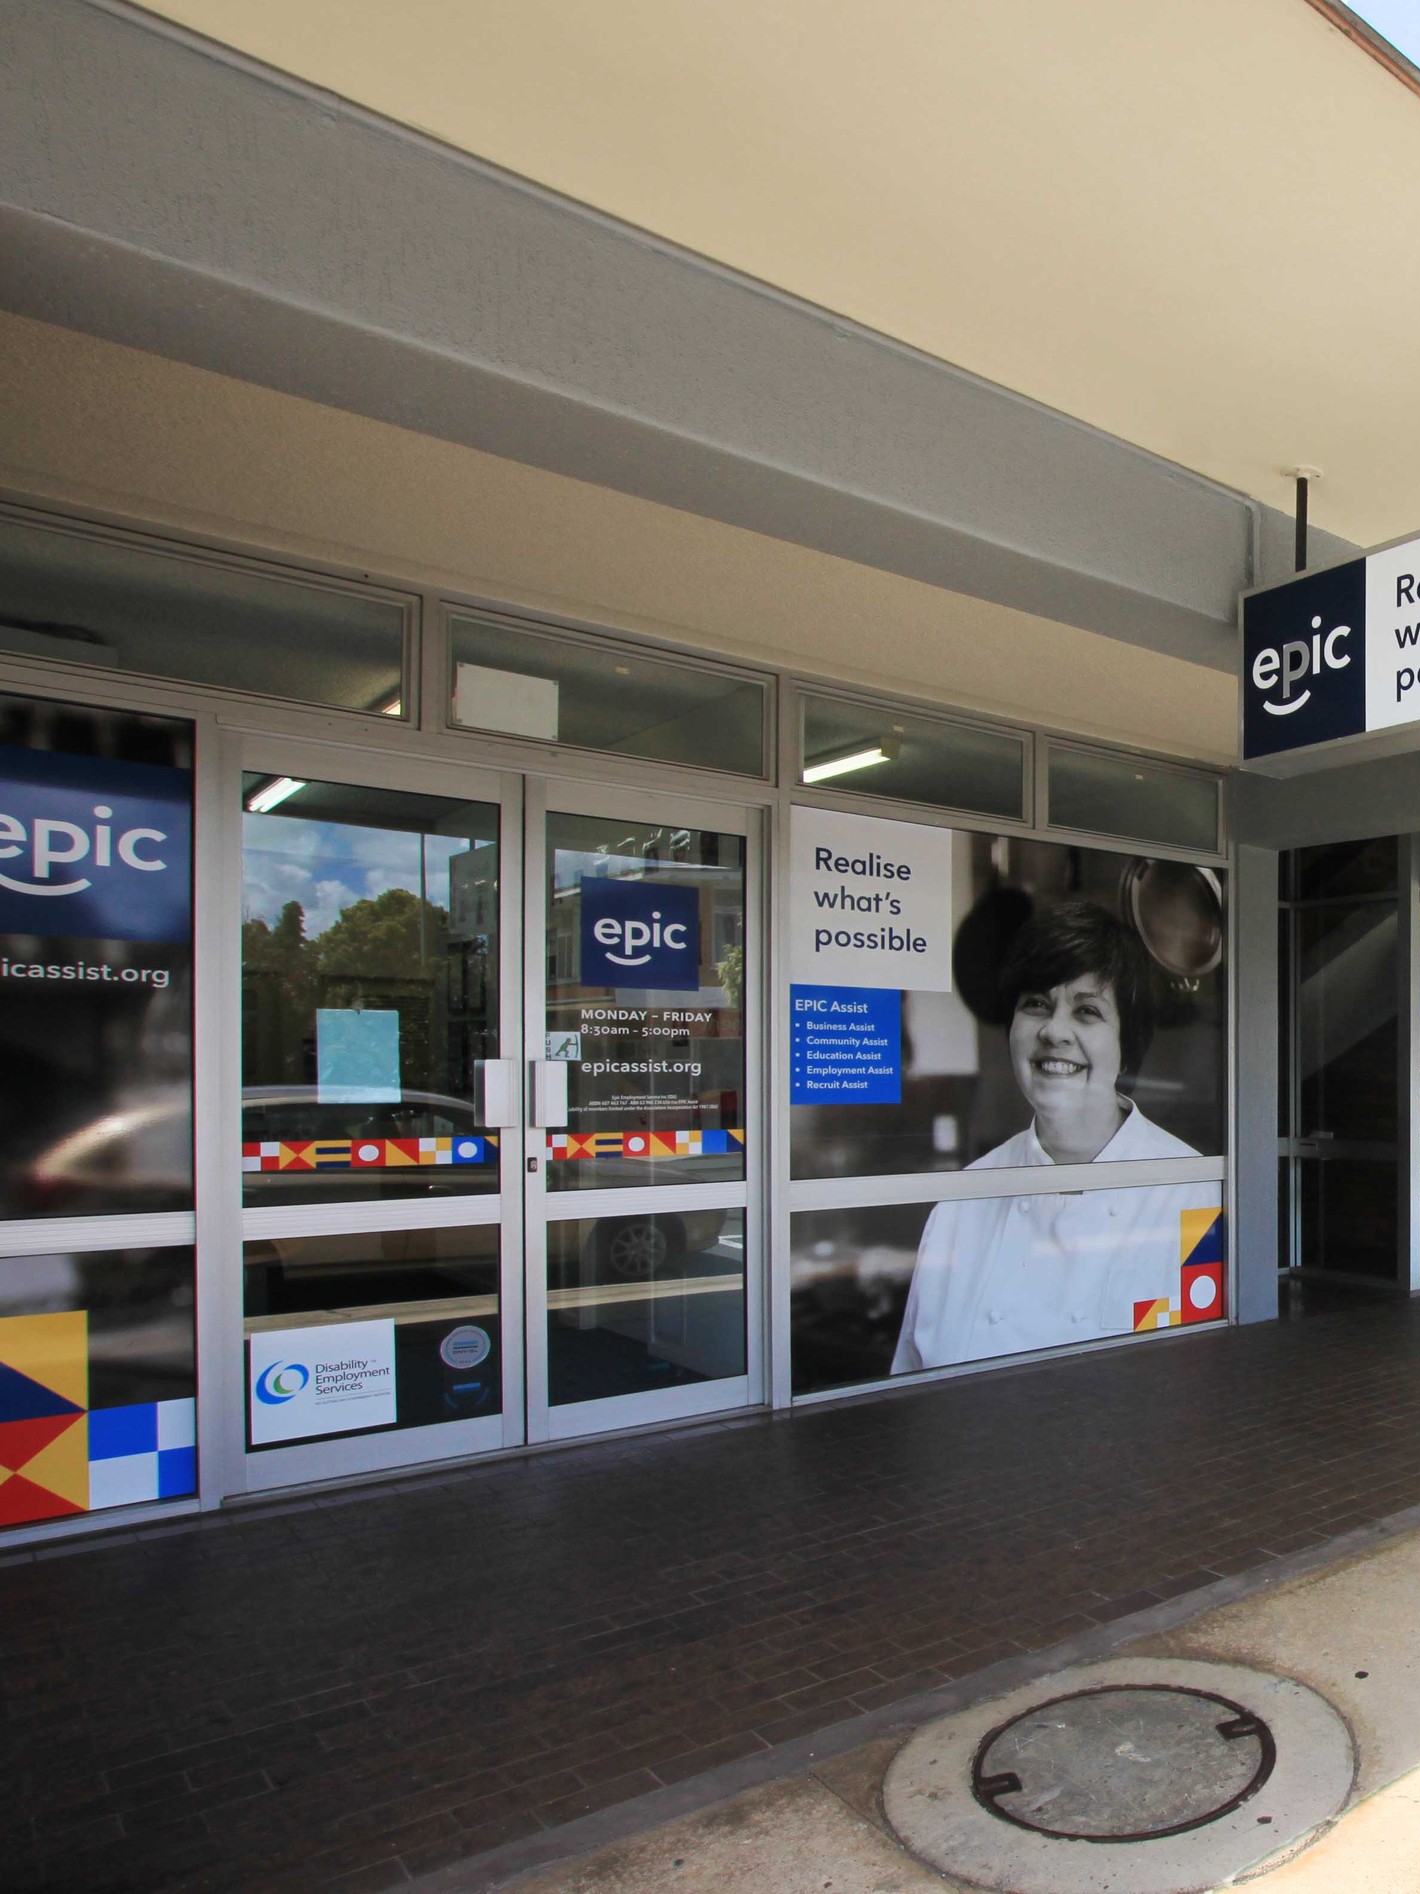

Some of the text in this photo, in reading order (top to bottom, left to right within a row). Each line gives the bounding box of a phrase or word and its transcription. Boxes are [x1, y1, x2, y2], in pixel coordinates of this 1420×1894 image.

[1252, 615, 1351, 699] epic
[815, 847, 911, 880] Realise
[813, 886, 901, 915] what's
[594, 911, 687, 955] epic
[815, 927, 927, 952] possible
[795, 1000, 868, 1013] EPIC Assist
[581, 1009, 647, 1021] MONDAY
[663, 1011, 712, 1022] FRIDAY
[581, 1024, 629, 1036] 8:30am
[642, 1025, 690, 1037] 5:00pm
[807, 1021, 875, 1032] Business Assist
[807, 1036, 888, 1047] Community Assist
[807, 1051, 881, 1060] Education Assist
[582, 1060, 702, 1076] epicassist.org
[807, 1066, 893, 1076] Employment Assist
[807, 1081, 868, 1089] Recruit Assist
[316, 1359, 368, 1374] Disability
[316, 1367, 391, 1385] Employment
[316, 1380, 363, 1396] Services
